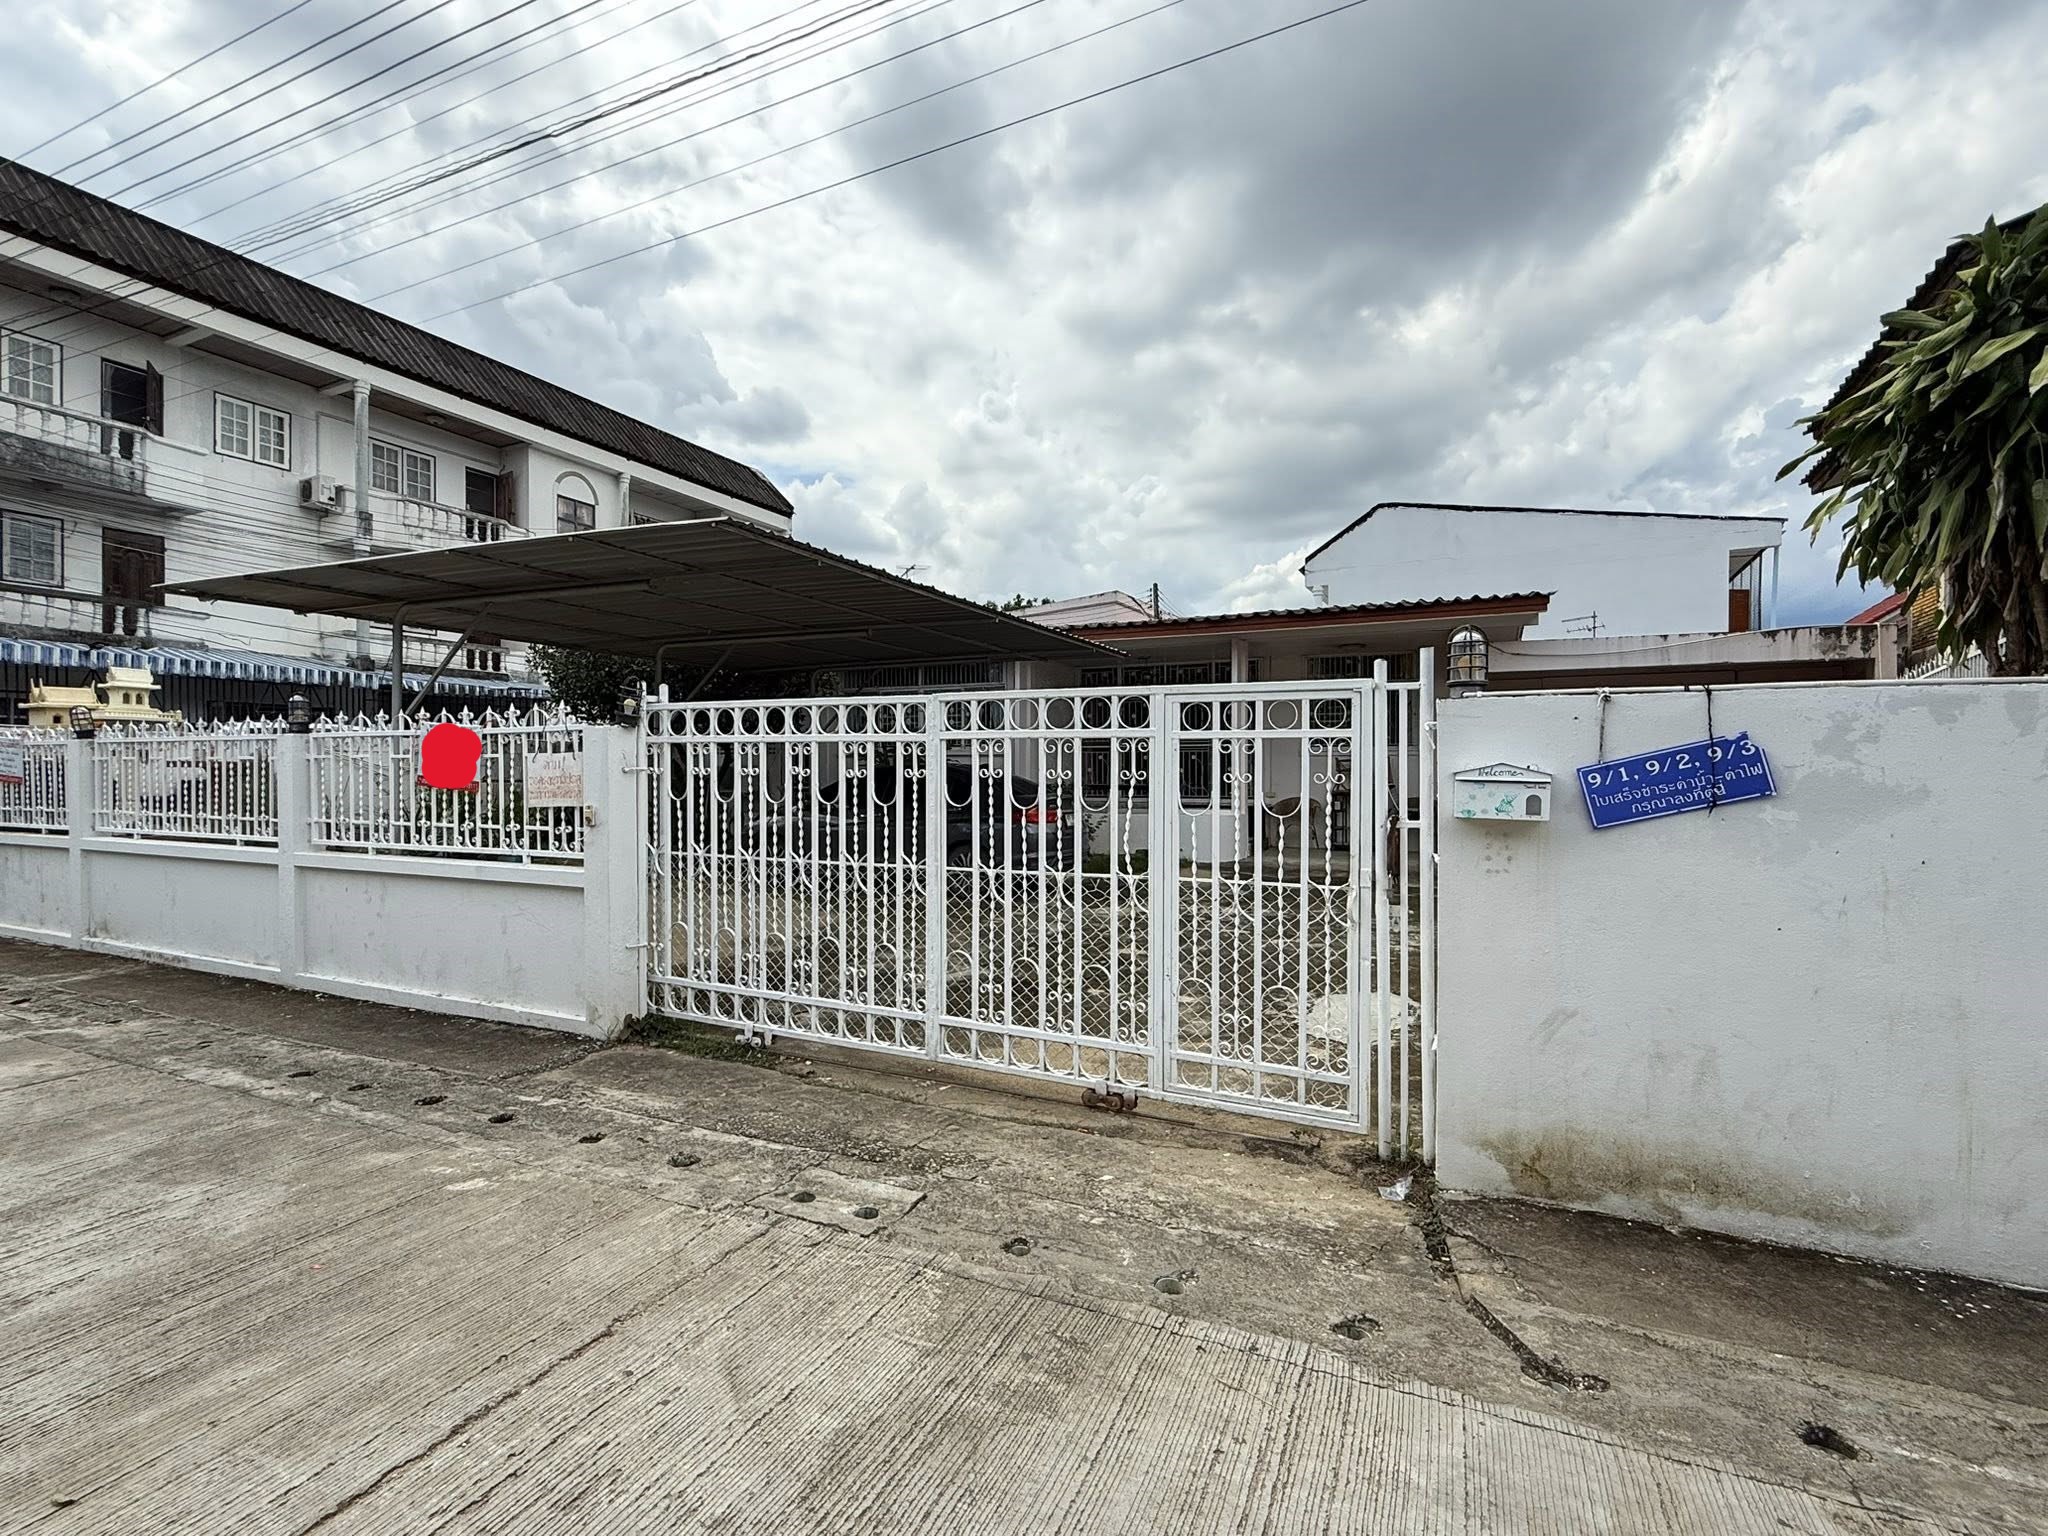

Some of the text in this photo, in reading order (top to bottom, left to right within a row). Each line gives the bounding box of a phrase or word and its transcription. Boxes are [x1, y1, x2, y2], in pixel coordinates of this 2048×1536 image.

[1587, 739, 1757, 789] 9/1, 9/2, 9/3
